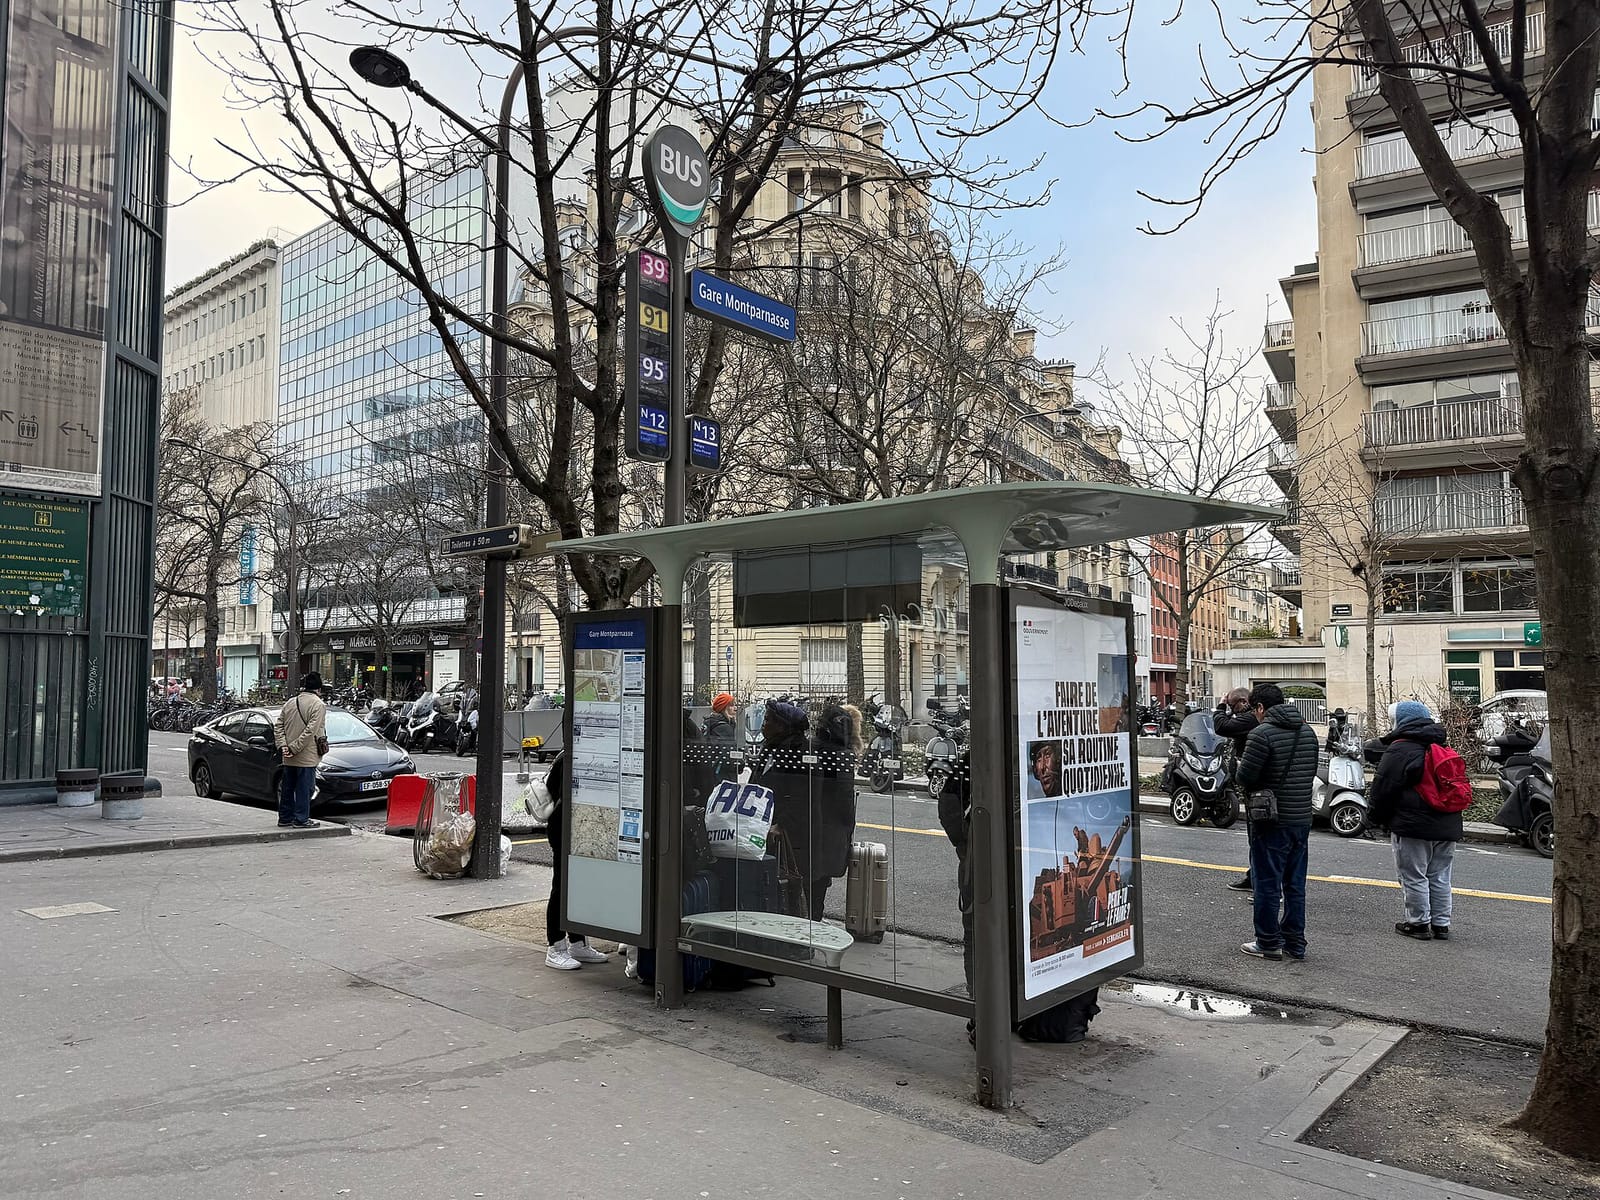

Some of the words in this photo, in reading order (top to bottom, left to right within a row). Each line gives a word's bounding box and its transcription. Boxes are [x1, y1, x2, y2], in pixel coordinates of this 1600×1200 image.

[660, 143, 702, 187] BUS
[643, 254, 665, 279] 39
[643, 305, 663, 329] 91
[698, 282, 722, 305] Gare
[725, 292, 790, 330] Montparnasse
[642, 356, 664, 381] 95
[16, 501, 54, 511] ASCENSEUR
[30, 526, 66, 535] ATLANTIQUE
[451, 540, 471, 550] Toilettes
[588, 630, 600, 638] Gare
[600, 629, 634, 638] Montparnasse
[1055, 681, 1084, 708] FAIRE
[1085, 681, 1098, 707] DE
[1037, 709, 1099, 738] L'AVENTURE
[1063, 738, 1076, 766] SA
[1078, 736, 1119, 764] ROUTINE
[1063, 762, 1128, 798] QUOTIDIENNE.
